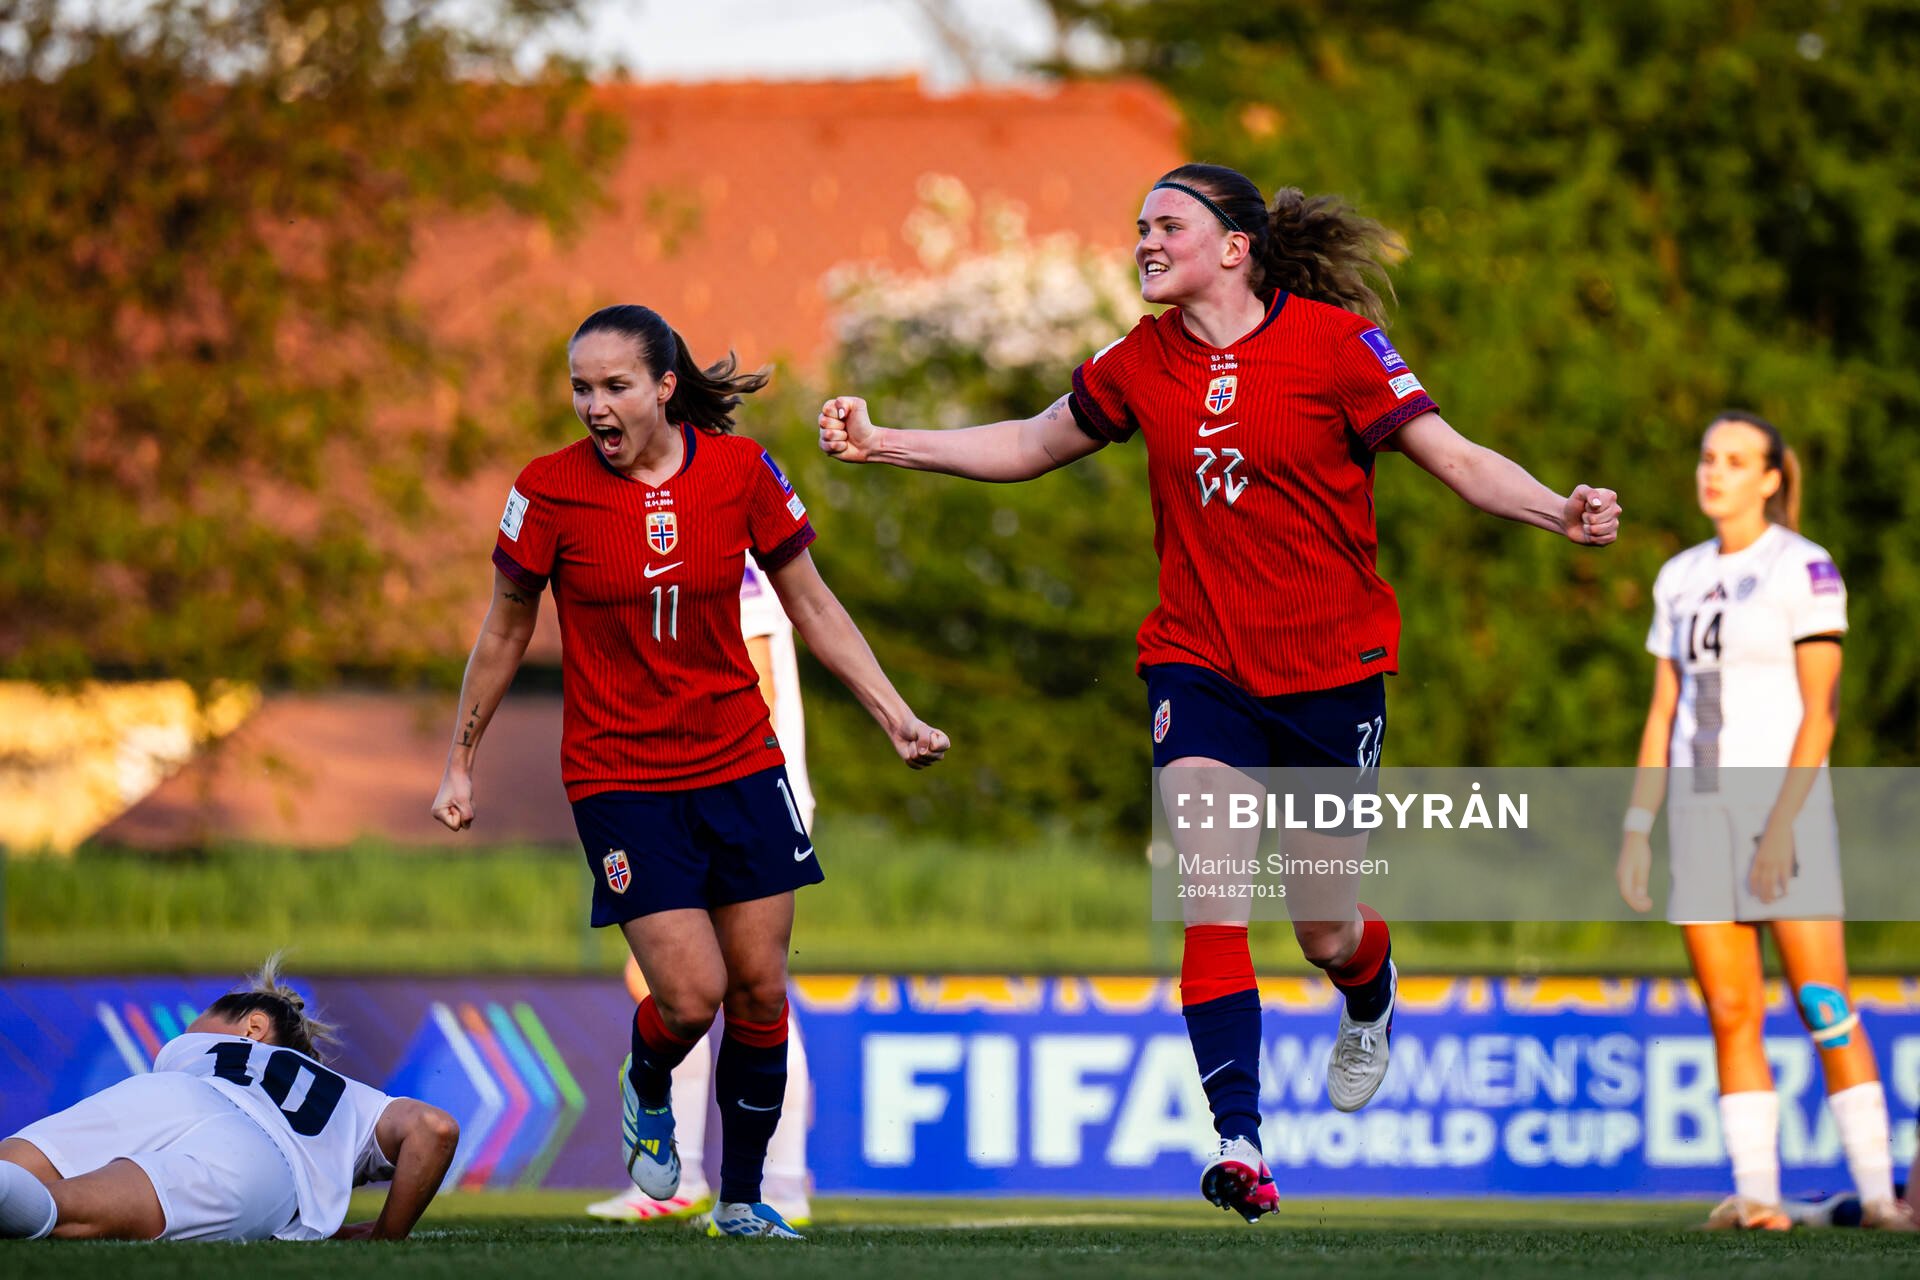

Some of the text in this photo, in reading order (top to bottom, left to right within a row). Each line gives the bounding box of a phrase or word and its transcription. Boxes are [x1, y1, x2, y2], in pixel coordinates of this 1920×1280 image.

[1193, 447, 1249, 507] 22
[649, 584, 679, 643] 11
[1687, 610, 1723, 662] 14
[1355, 714, 1384, 785] 22
[205, 1042, 347, 1137] 10
[862, 1033, 1223, 1168] FIFA
[1504, 1109, 1641, 1168] CUP
